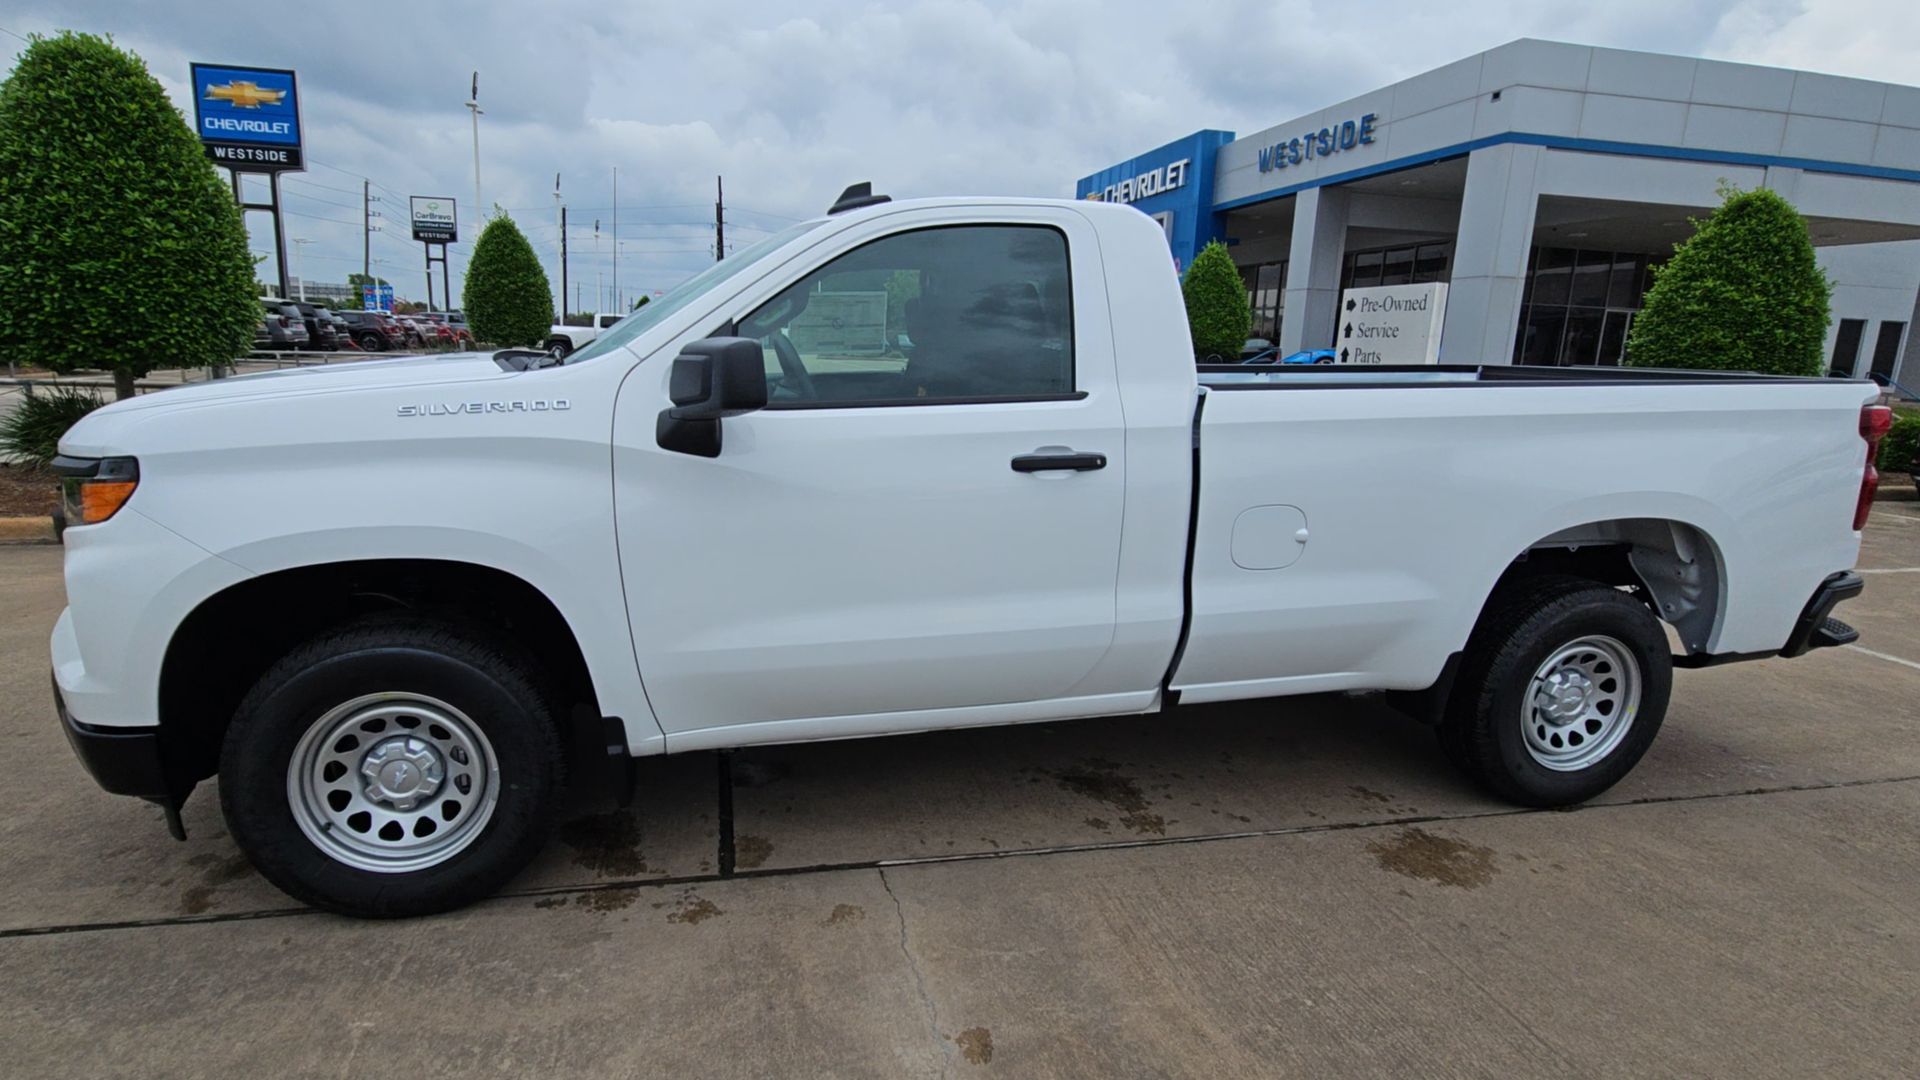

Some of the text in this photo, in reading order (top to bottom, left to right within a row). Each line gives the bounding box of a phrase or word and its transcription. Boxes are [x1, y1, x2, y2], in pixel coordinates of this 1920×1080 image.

[204, 117, 290, 134] CHEVROLET
[1258, 113, 1378, 173] WESTSIDE
[214, 146, 288, 162] WESTSIDE
[1104, 158, 1190, 204] CHEVROLET
[415, 211, 452, 221] CarBravo
[1360, 293, 1428, 313] Pre-Owned
[1357, 321, 1399, 338] Service
[1354, 347, 1381, 364] Parts
[397, 399, 571, 417] SILVERADO
